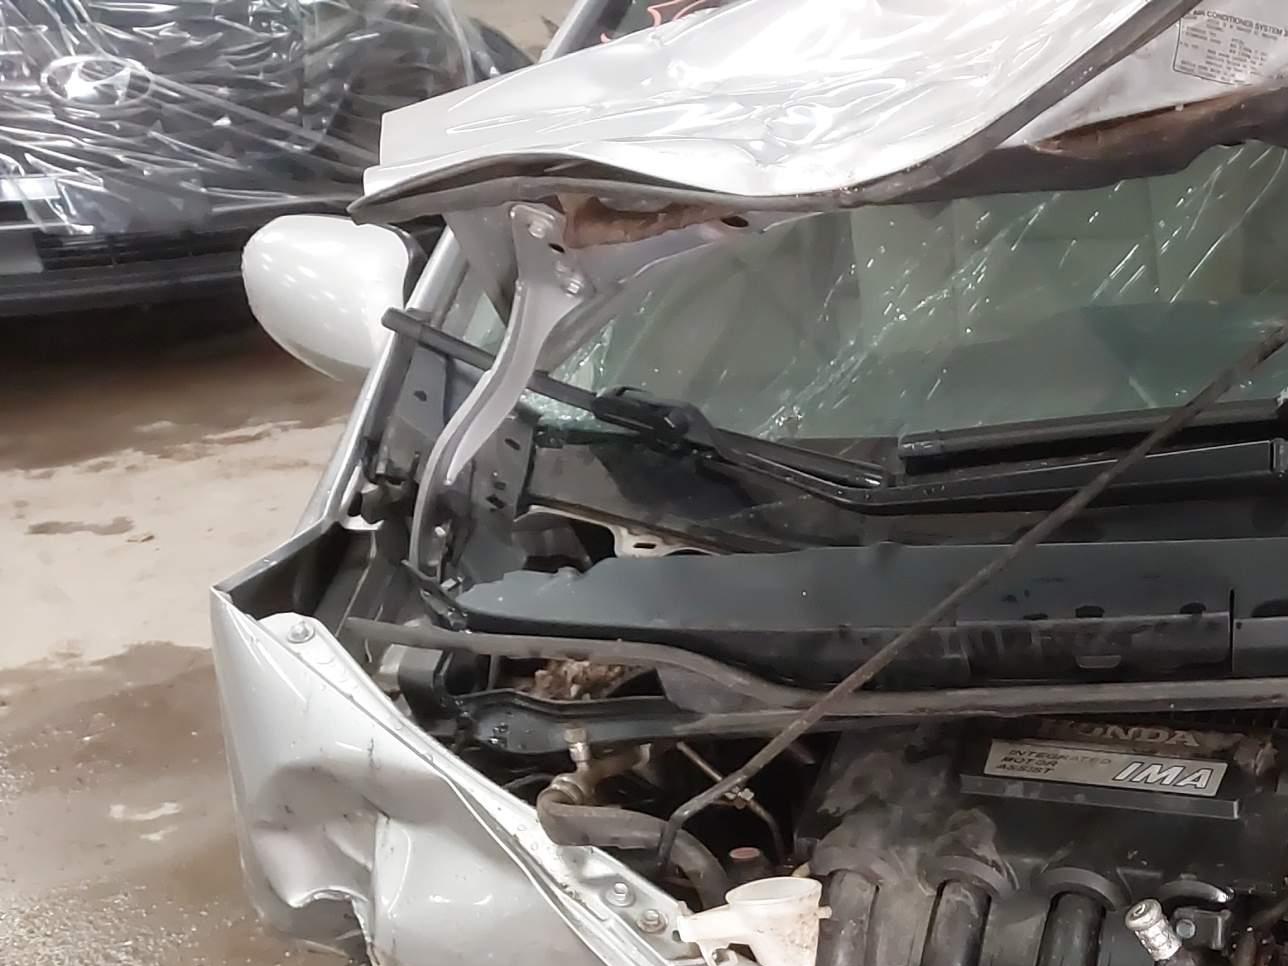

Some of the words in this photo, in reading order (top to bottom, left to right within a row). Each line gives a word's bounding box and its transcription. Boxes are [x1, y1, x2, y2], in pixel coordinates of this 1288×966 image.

[1255, 23, 1283, 35] SYSTEM
[1000, 756, 1060, 768] MOTOR
[1007, 749, 1112, 765] INTEGRATED
[995, 763, 1056, 775] ASSIST
[1112, 761, 1214, 790] IMA
